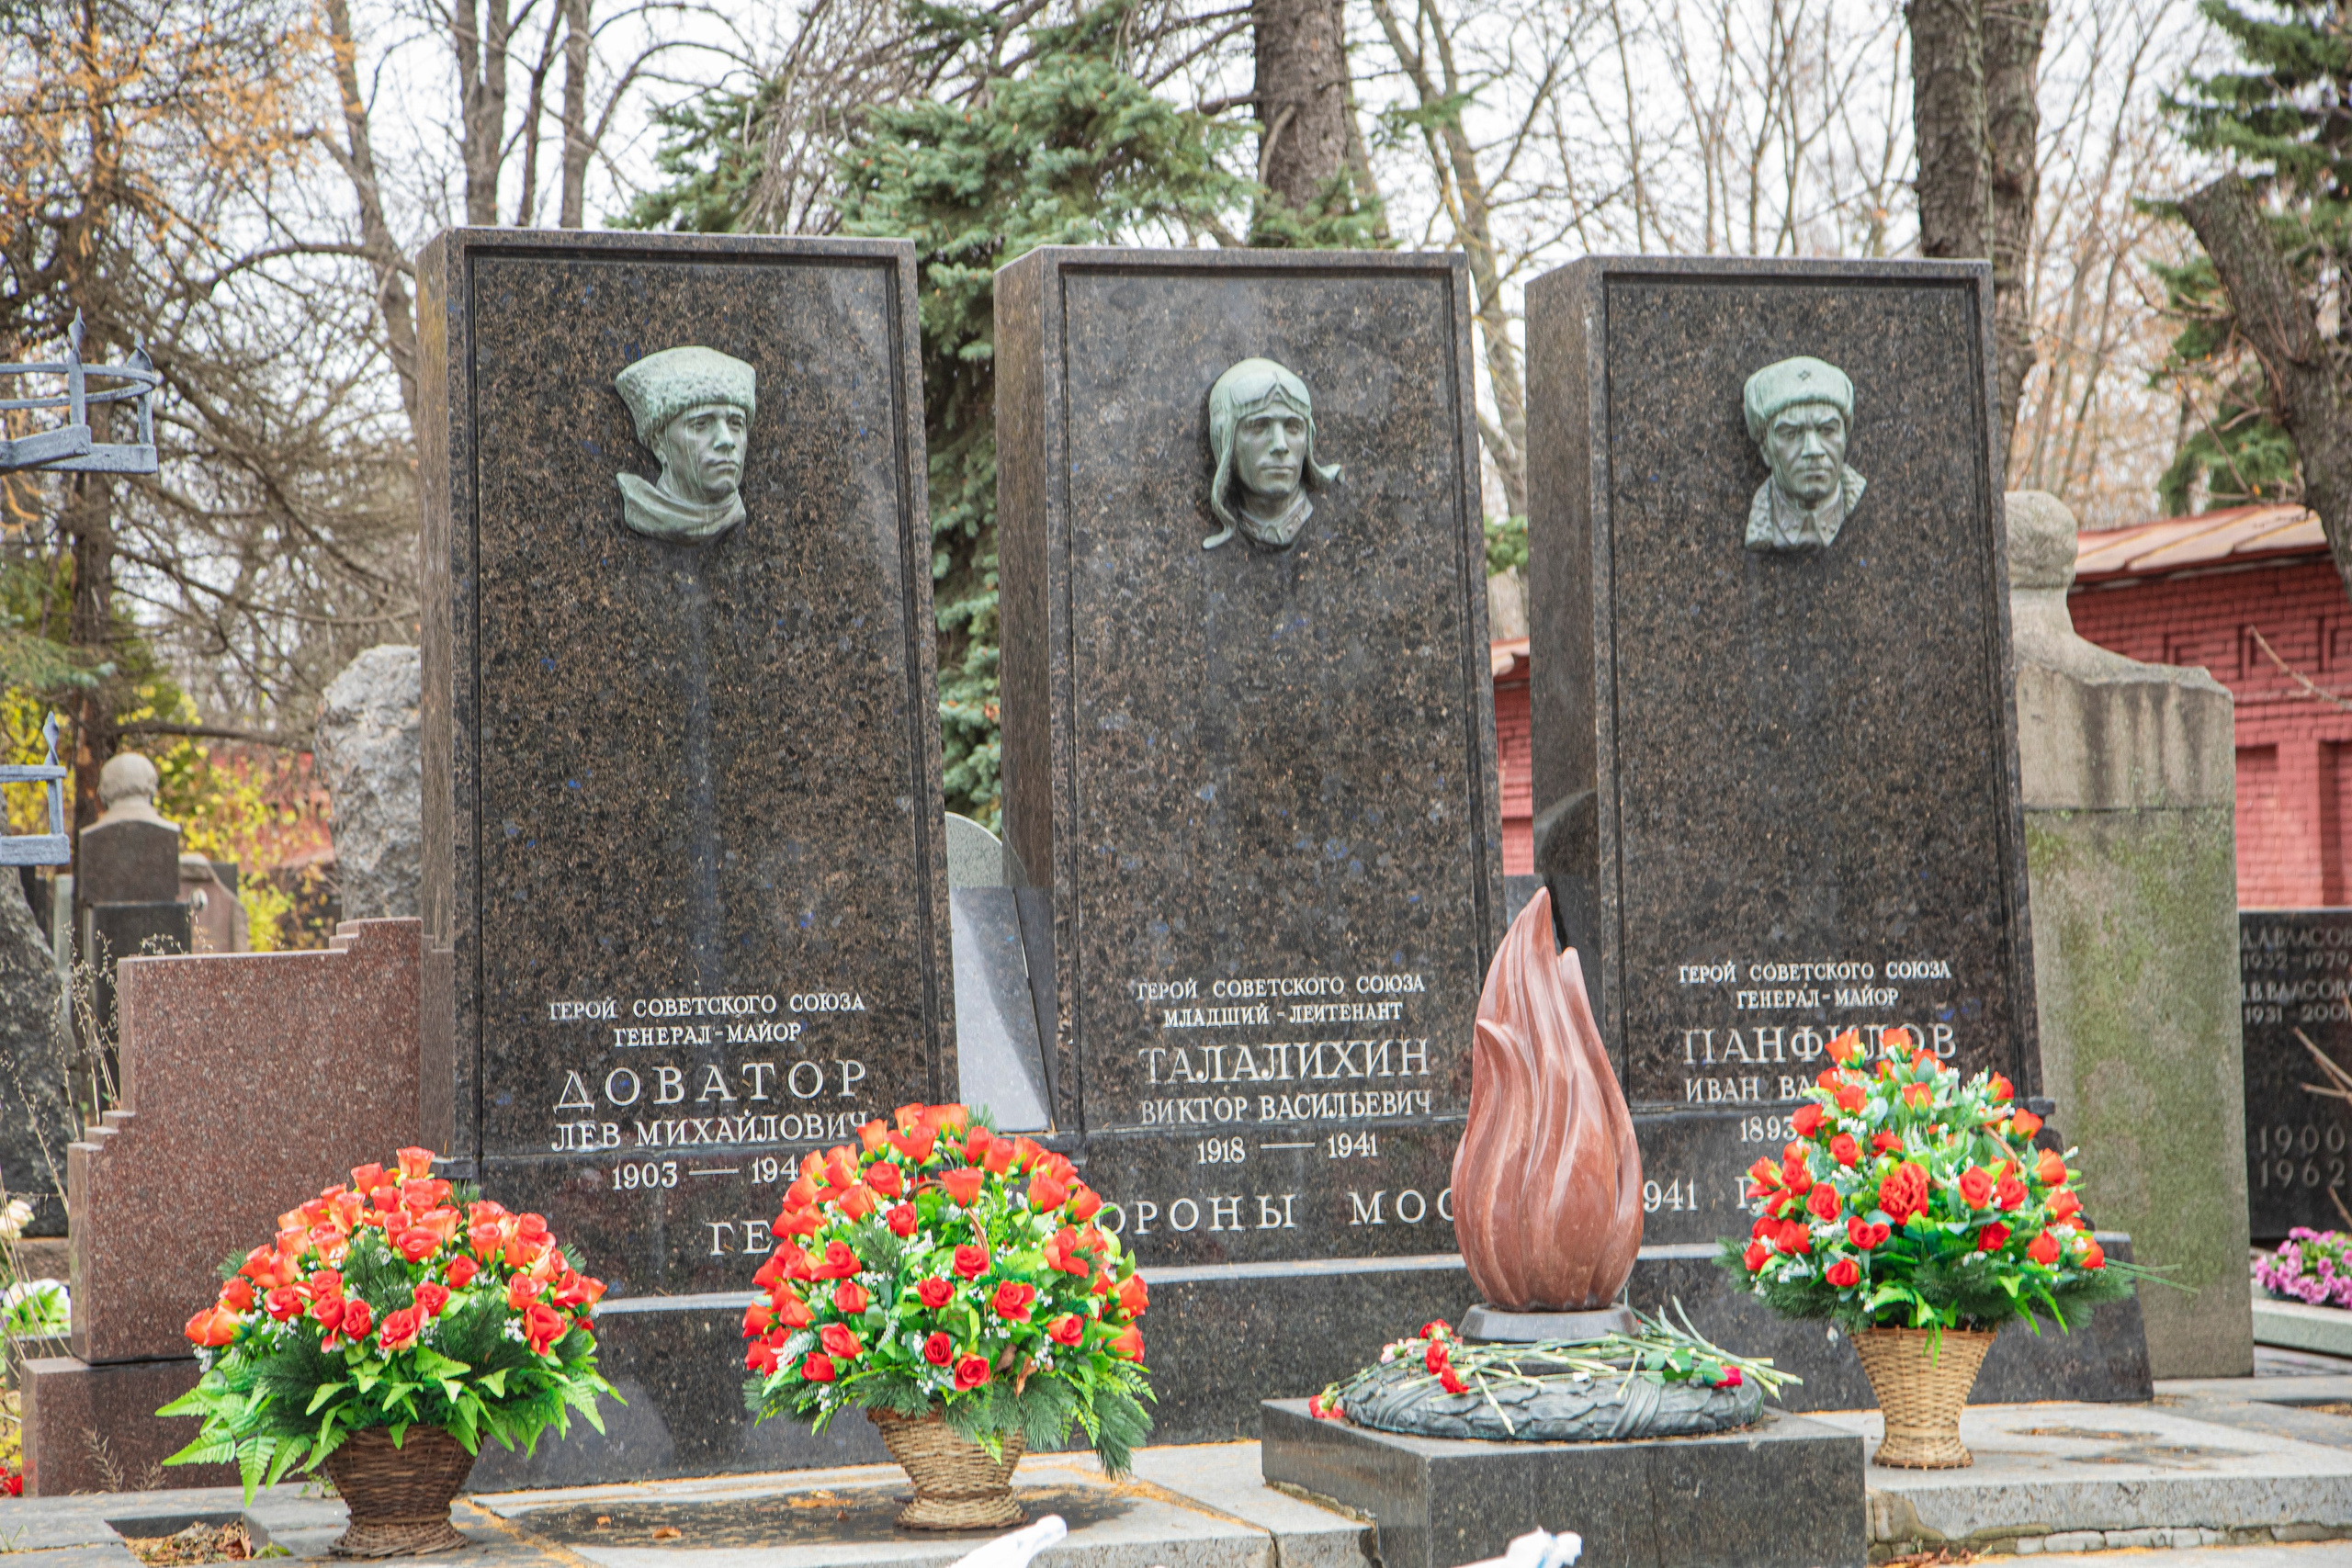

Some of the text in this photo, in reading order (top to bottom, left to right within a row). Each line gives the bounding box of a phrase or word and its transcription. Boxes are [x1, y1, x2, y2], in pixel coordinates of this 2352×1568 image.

[1136, 974, 1425, 1001] ГЕРОЙ СОВЕТСКОГО СОЮЗА
[1679, 960, 1951, 984] ГЕРОЙ СОВЕТСКОГО СОЮЗА
[549, 992, 865, 1021] ГЕРОЙ СОВЕТСКОГО СОЮЗА
[1138, 1038, 1430, 1085] ТАЛАЛИХИН
[553, 1059, 866, 1113] ДОВАТОР
[1685, 1076, 1759, 1103] ИВАН
[1141, 1089, 1431, 1125] ВИКТОР ВАСИЛЬЕВИЧ
[551, 1109, 868, 1152] ЛЕВ МИХАЙЛОВИЧ
[2260, 1122, 2346, 1155] 1900
[1197, 1136, 1245, 1165] 1918
[1328, 1131, 1377, 1158] 1941
[612, 1161, 678, 1190] 1903
[752, 1154, 800, 1184] 194
[2261, 1157, 2346, 1189] 1962
[1094, 1194, 1298, 1235] ОРОНЫ
[1643, 1177, 1699, 1213] 941
